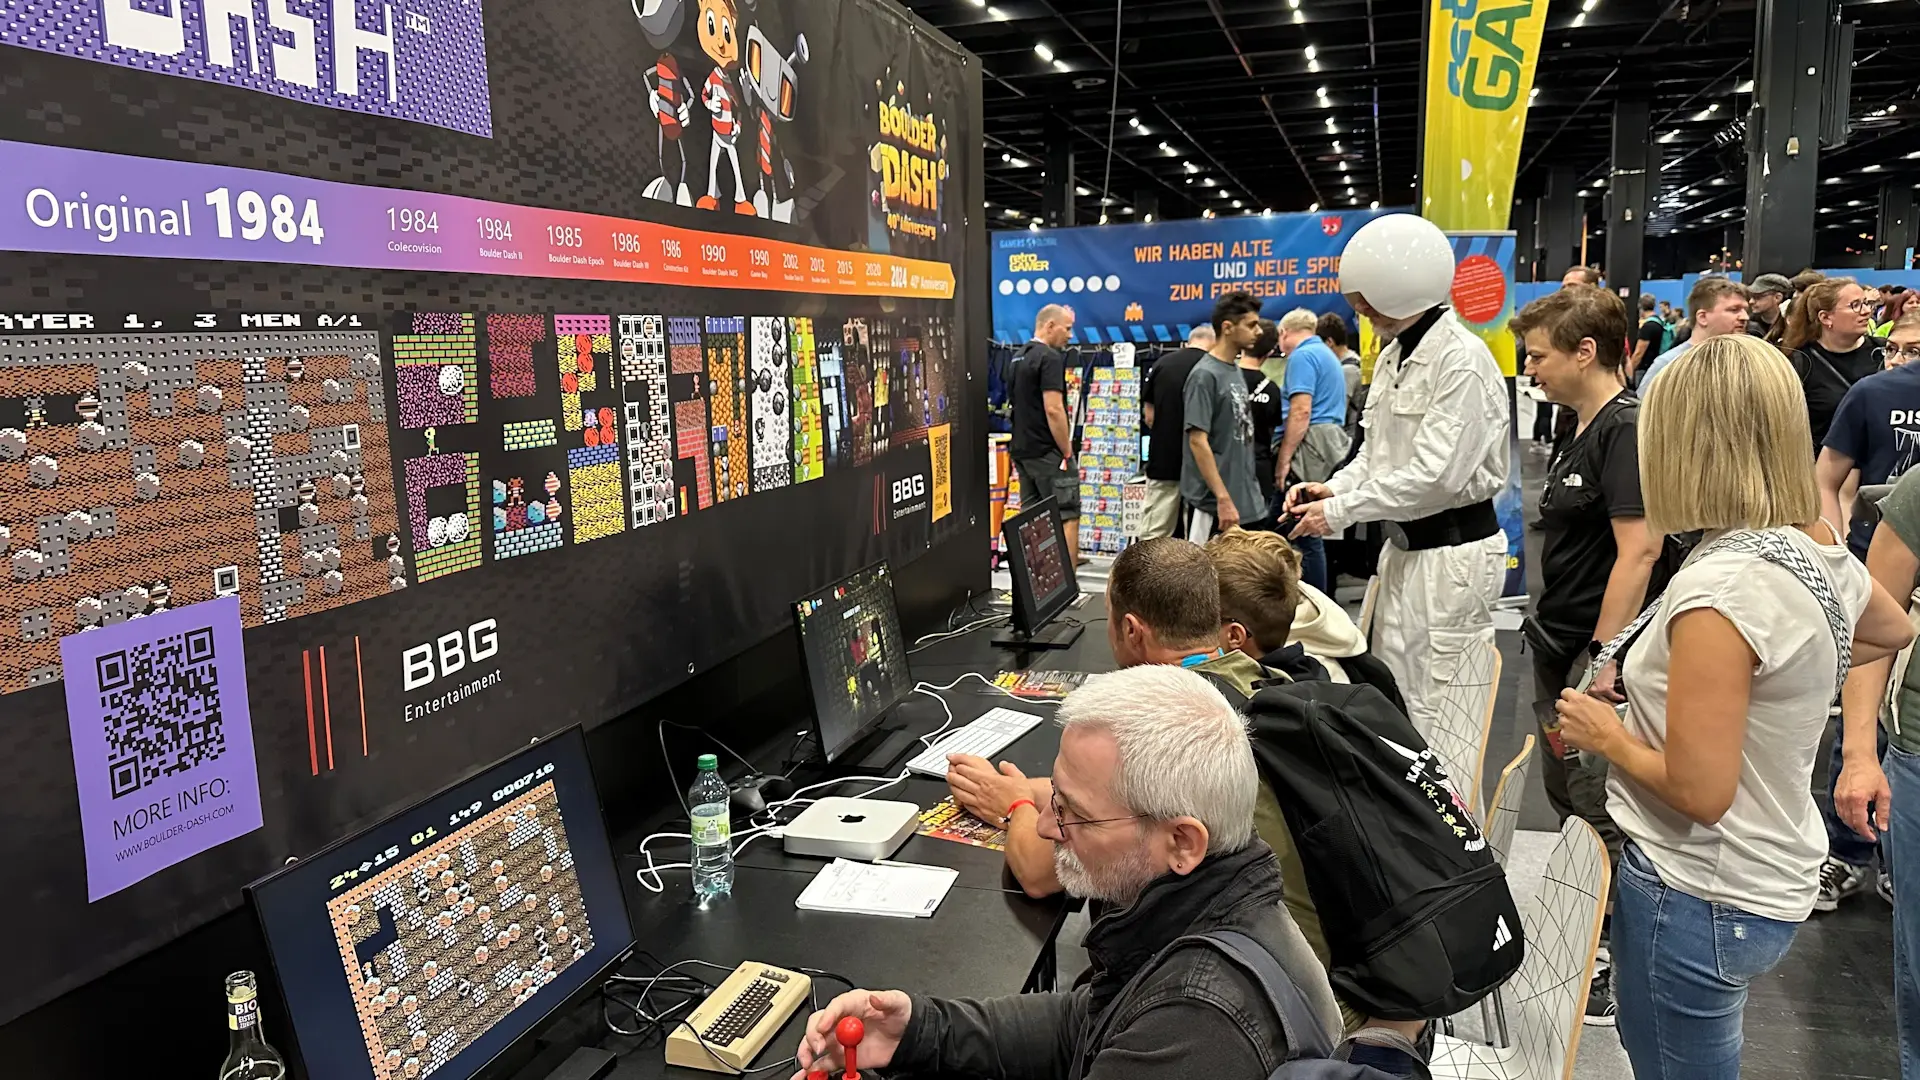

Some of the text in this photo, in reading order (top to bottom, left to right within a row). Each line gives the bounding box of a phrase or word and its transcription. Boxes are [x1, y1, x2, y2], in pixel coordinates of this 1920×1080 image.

[1462, 0, 1533, 111] GA
[879, 101, 937, 153] BOULDER
[880, 143, 937, 211] DASH
[25, 187, 325, 245] Original 1984
[386, 207, 439, 235] 1984
[476, 216, 513, 242] 1984
[546, 225, 583, 248] 1985
[387, 240, 442, 254] Colecovision
[612, 232, 641, 254] 1986
[661, 239, 682, 259] 1986
[701, 244, 726, 263] 1990
[1134, 239, 1273, 263] WIR HABEN ALTE
[479, 248, 502, 259] Boulder
[502, 248, 517, 261] Dash
[548, 253, 605, 268] Boulder Dash Epoch
[613, 258, 632, 268] Boulder
[750, 249, 770, 267] 1990
[783, 253, 799, 270] 2002
[810, 257, 826, 273] 2012
[837, 260, 853, 275] 2015
[866, 263, 882, 277] 2020
[1009, 260, 1049, 272] GAMER
[1213, 261, 1247, 279] UND
[1254, 258, 1299, 276] NEUE
[891, 265, 908, 289] 2024
[920, 275, 949, 296] Anniversary
[1169, 284, 1203, 301] ZUM
[1294, 276, 1340, 295] GERN
[194, 314, 217, 328] 3
[241, 313, 301, 328] MEN
[317, 314, 362, 328] A/1
[892, 474, 925, 504] BBG
[893, 501, 926, 519] Entertainment
[403, 618, 498, 691] BBG
[405, 669, 501, 722] Entertainment
[112, 777, 231, 841] MORE INFO:
[374, 845, 400, 867] 15
[410, 826, 437, 846] 01
[449, 800, 483, 826] 149
[492, 763, 555, 802] 000716
[115, 804, 235, 862] WWW.BOULDER-DASH.COM
[235, 1000, 257, 1015] BIO
